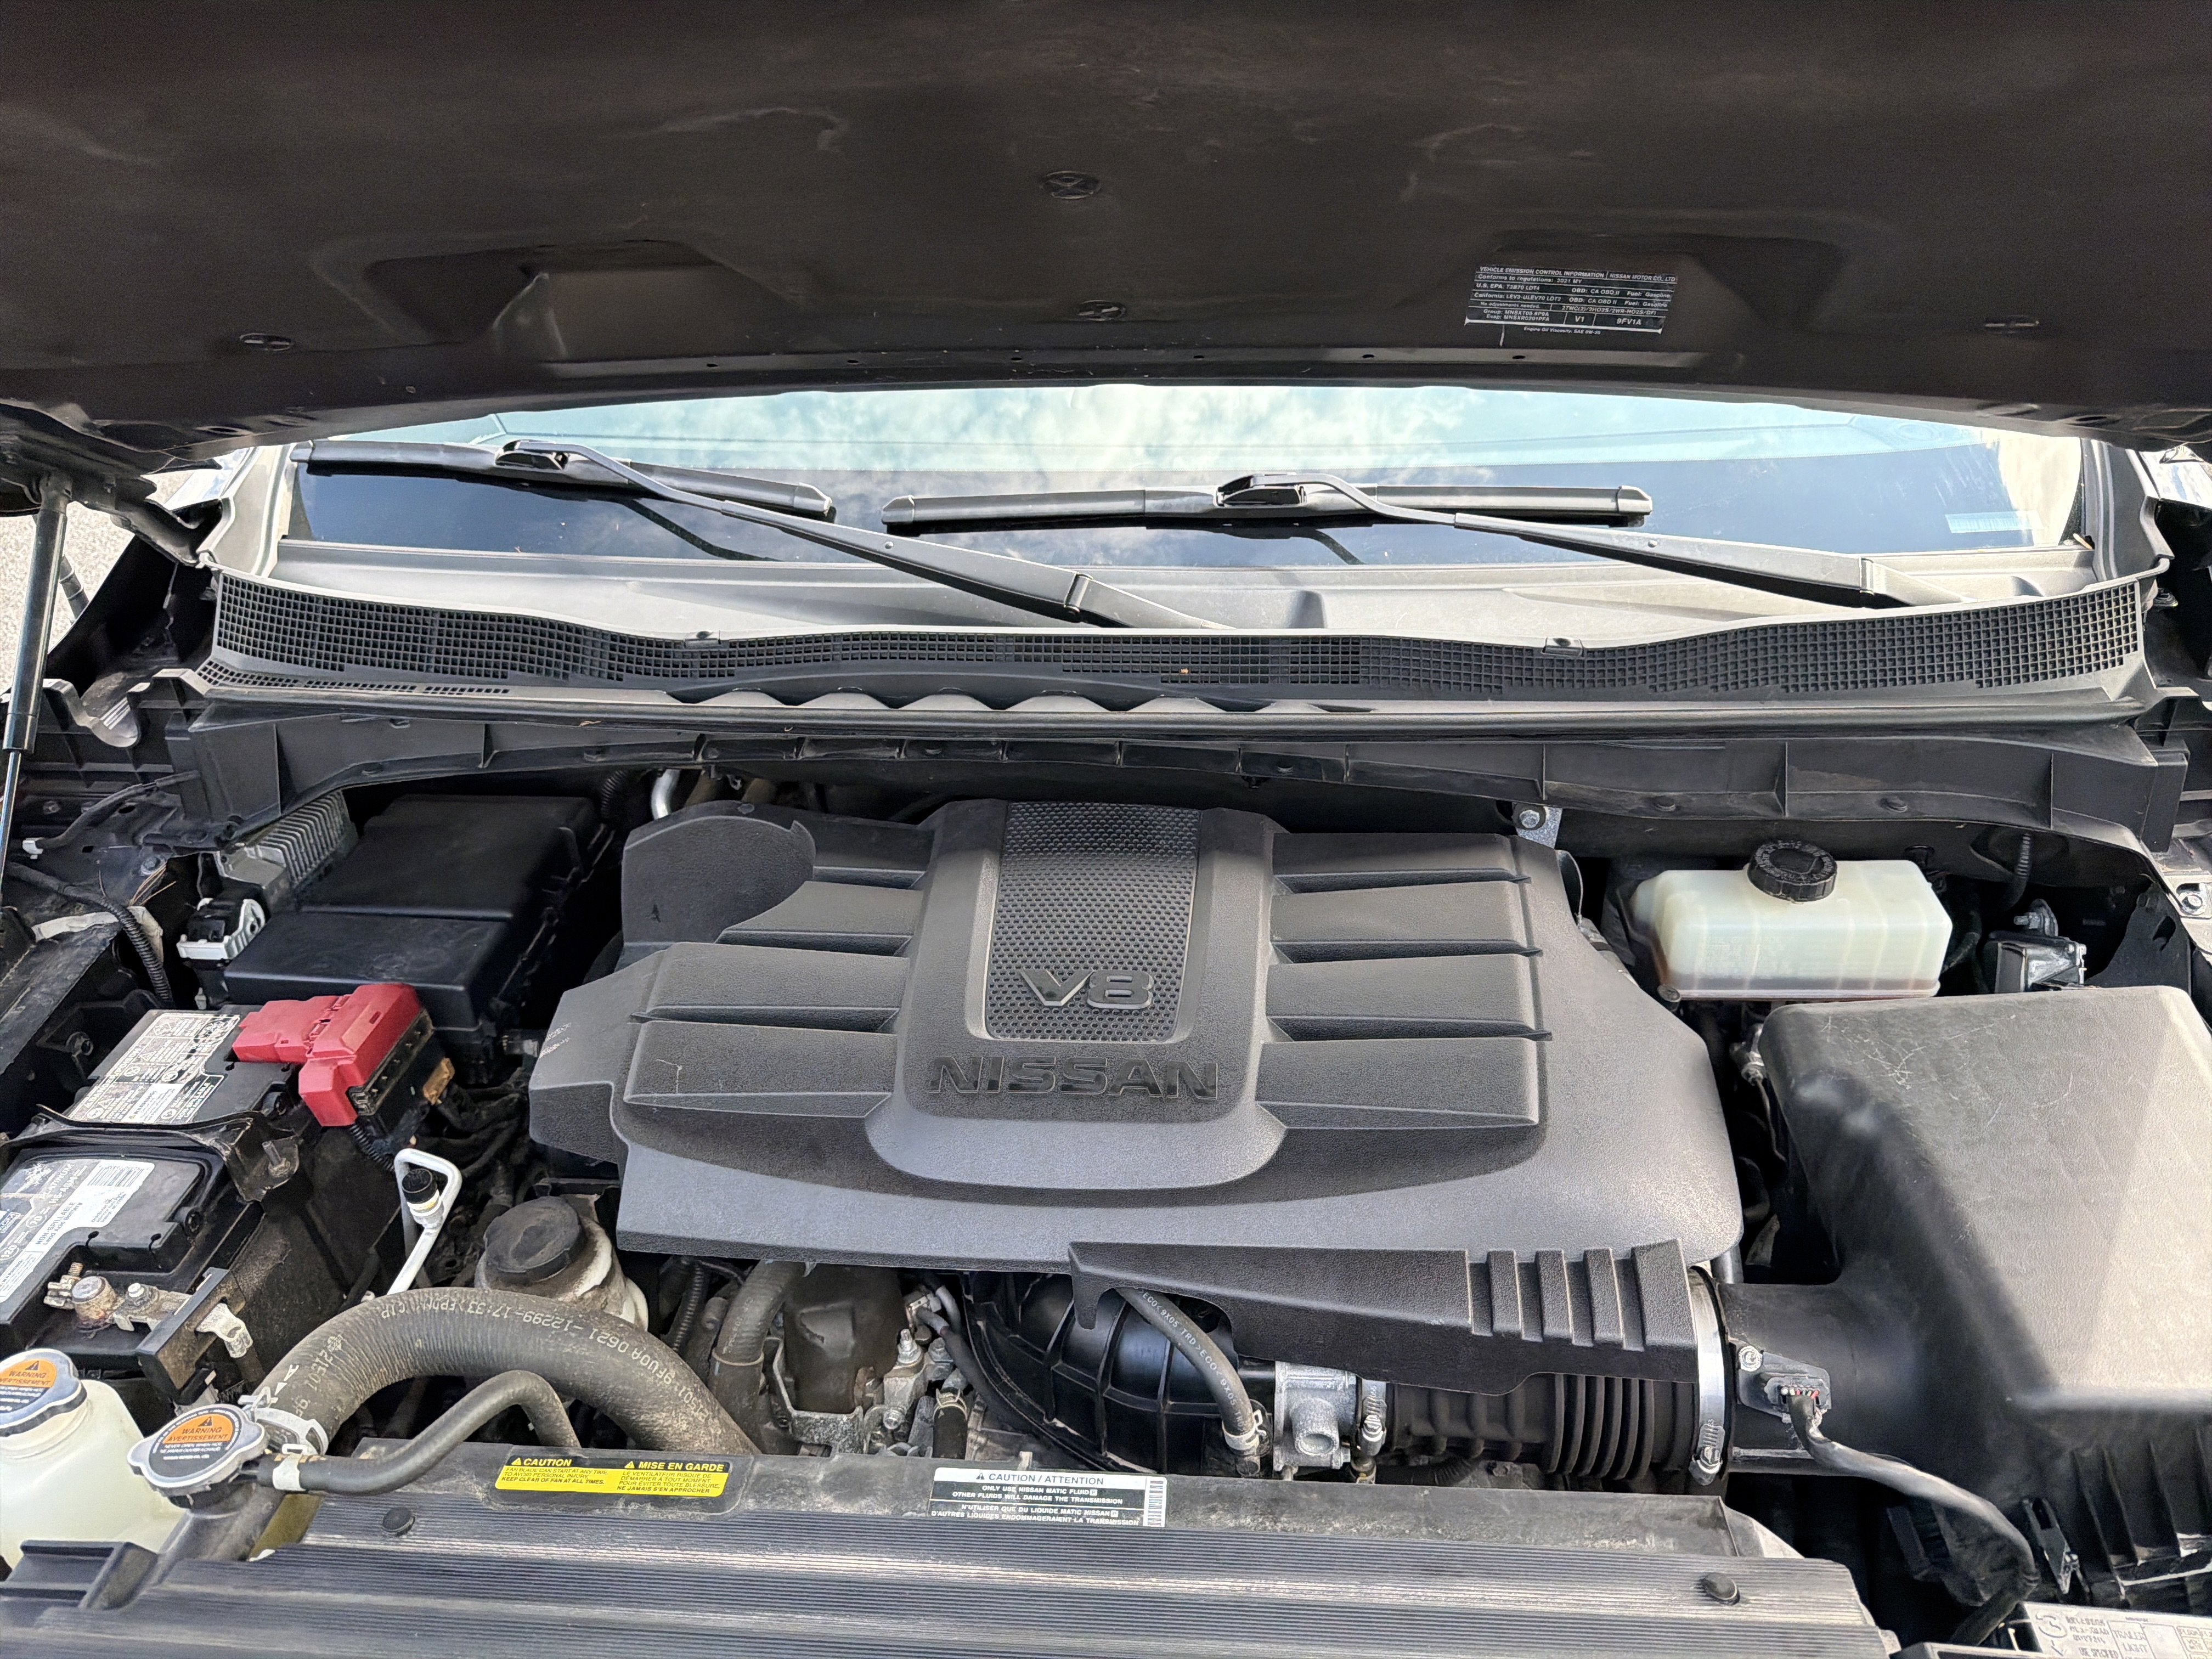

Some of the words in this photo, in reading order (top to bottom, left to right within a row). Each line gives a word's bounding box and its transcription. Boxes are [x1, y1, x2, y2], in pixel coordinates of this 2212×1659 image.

[1020, 969, 1153, 1010] V8
[929, 1055, 1218, 1099] NISSAN
[39, 1163, 75, 1200] PLATINUM
[29, 1215, 43, 1226] 70
[35, 1202, 76, 1245] NON-SPILLABLE
[43, 1231, 54, 1245] Lead
[54, 1221, 66, 1234] Acid
[65, 1202, 83, 1222] Battery
[1, 1245, 18, 1258] 120
[589, 1328, 630, 1353] 0621
[1181, 1328, 1196, 1345] TRD
[9, 1370, 47, 1379] WARNING
[167, 1434, 229, 1442] AVERTISSEMENT
[639, 1462, 665, 1470] MISE
[686, 1464, 725, 1472] GARDE
[989, 1473, 1036, 1482] CAUTION
[1045, 1476, 1104, 1485] ATTENTION
[1001, 1514, 1073, 1523] ENDOMMAGERAIENT
[1086, 1517, 1139, 1526] TRANSMISSION
